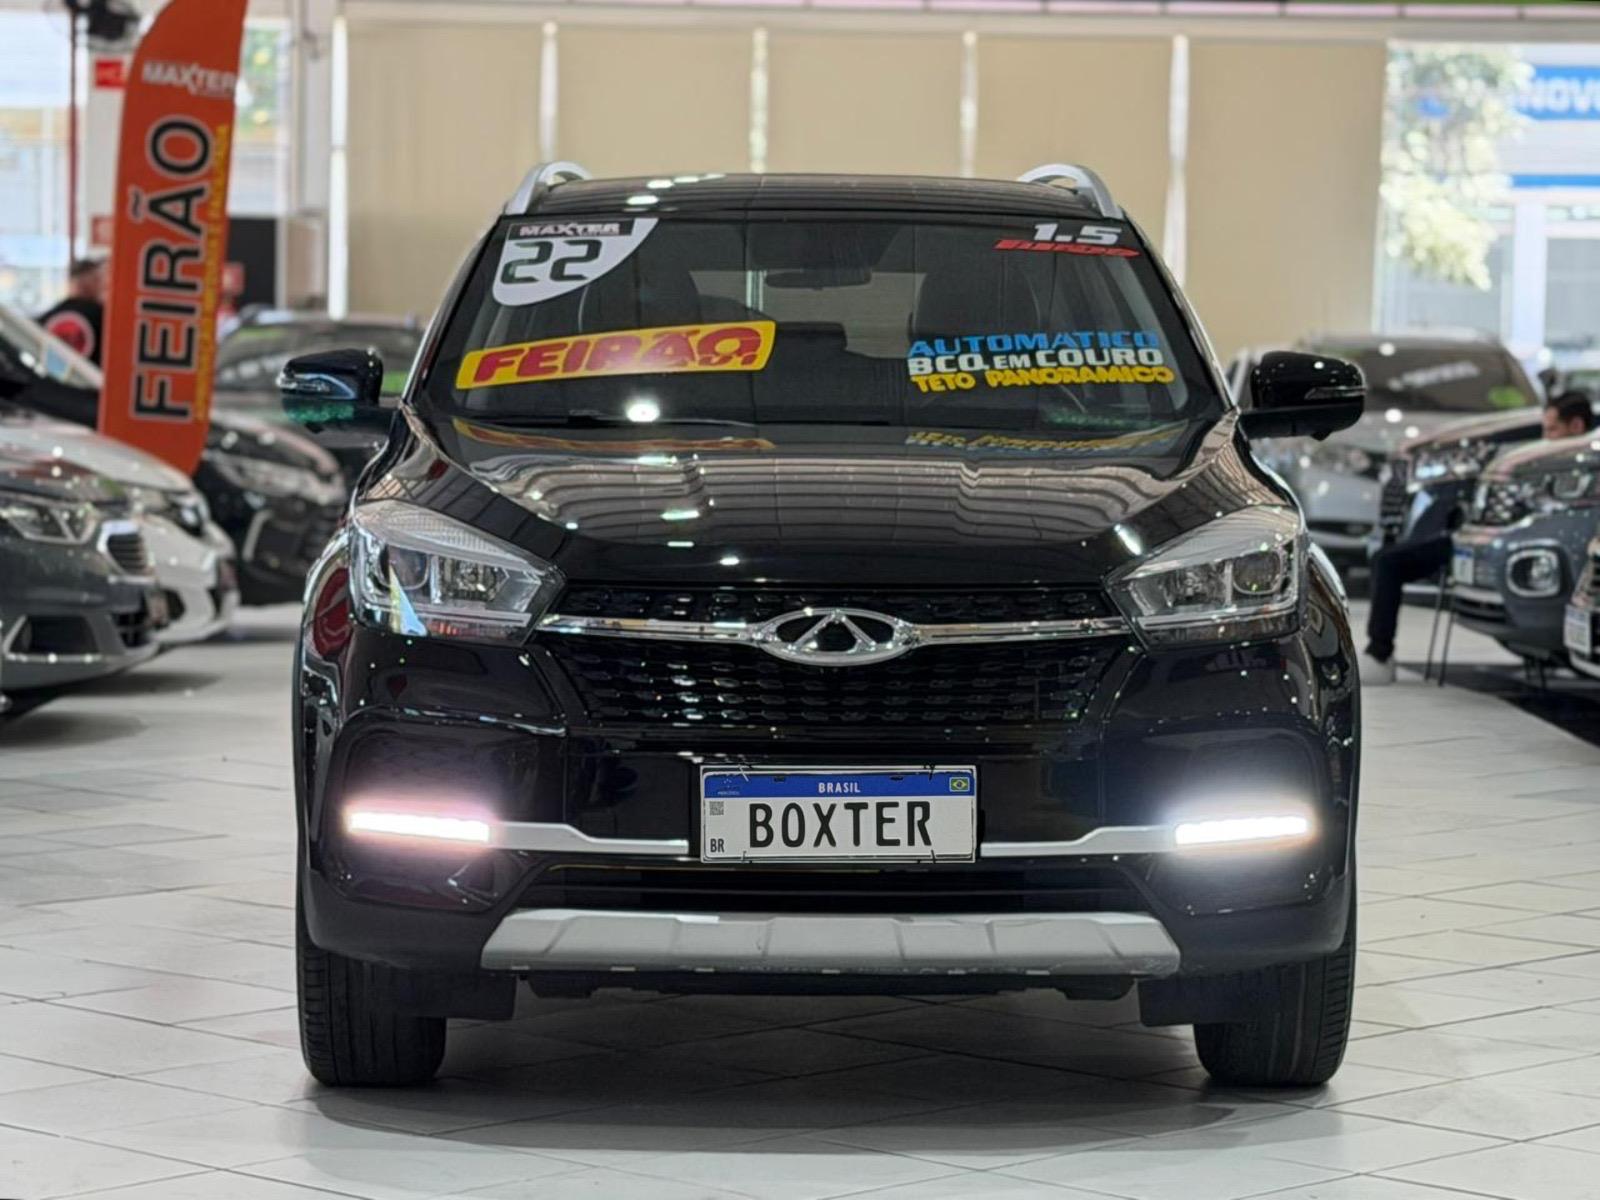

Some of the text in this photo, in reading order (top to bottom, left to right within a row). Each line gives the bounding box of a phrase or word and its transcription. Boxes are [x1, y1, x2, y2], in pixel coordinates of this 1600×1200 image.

[519, 222, 621, 237] MAXTER
[1034, 223, 1122, 246] 1.5
[131, 118, 213, 422] FEIRÃO
[501, 239, 603, 284] 22
[993, 354, 1031, 370] EM
[1036, 348, 1165, 368] COURO
[911, 365, 1175, 393] TETO PANORAMICO
[818, 782, 861, 794] BRASIL
[749, 801, 932, 848] BOXTER
[710, 838, 725, 853] BR
